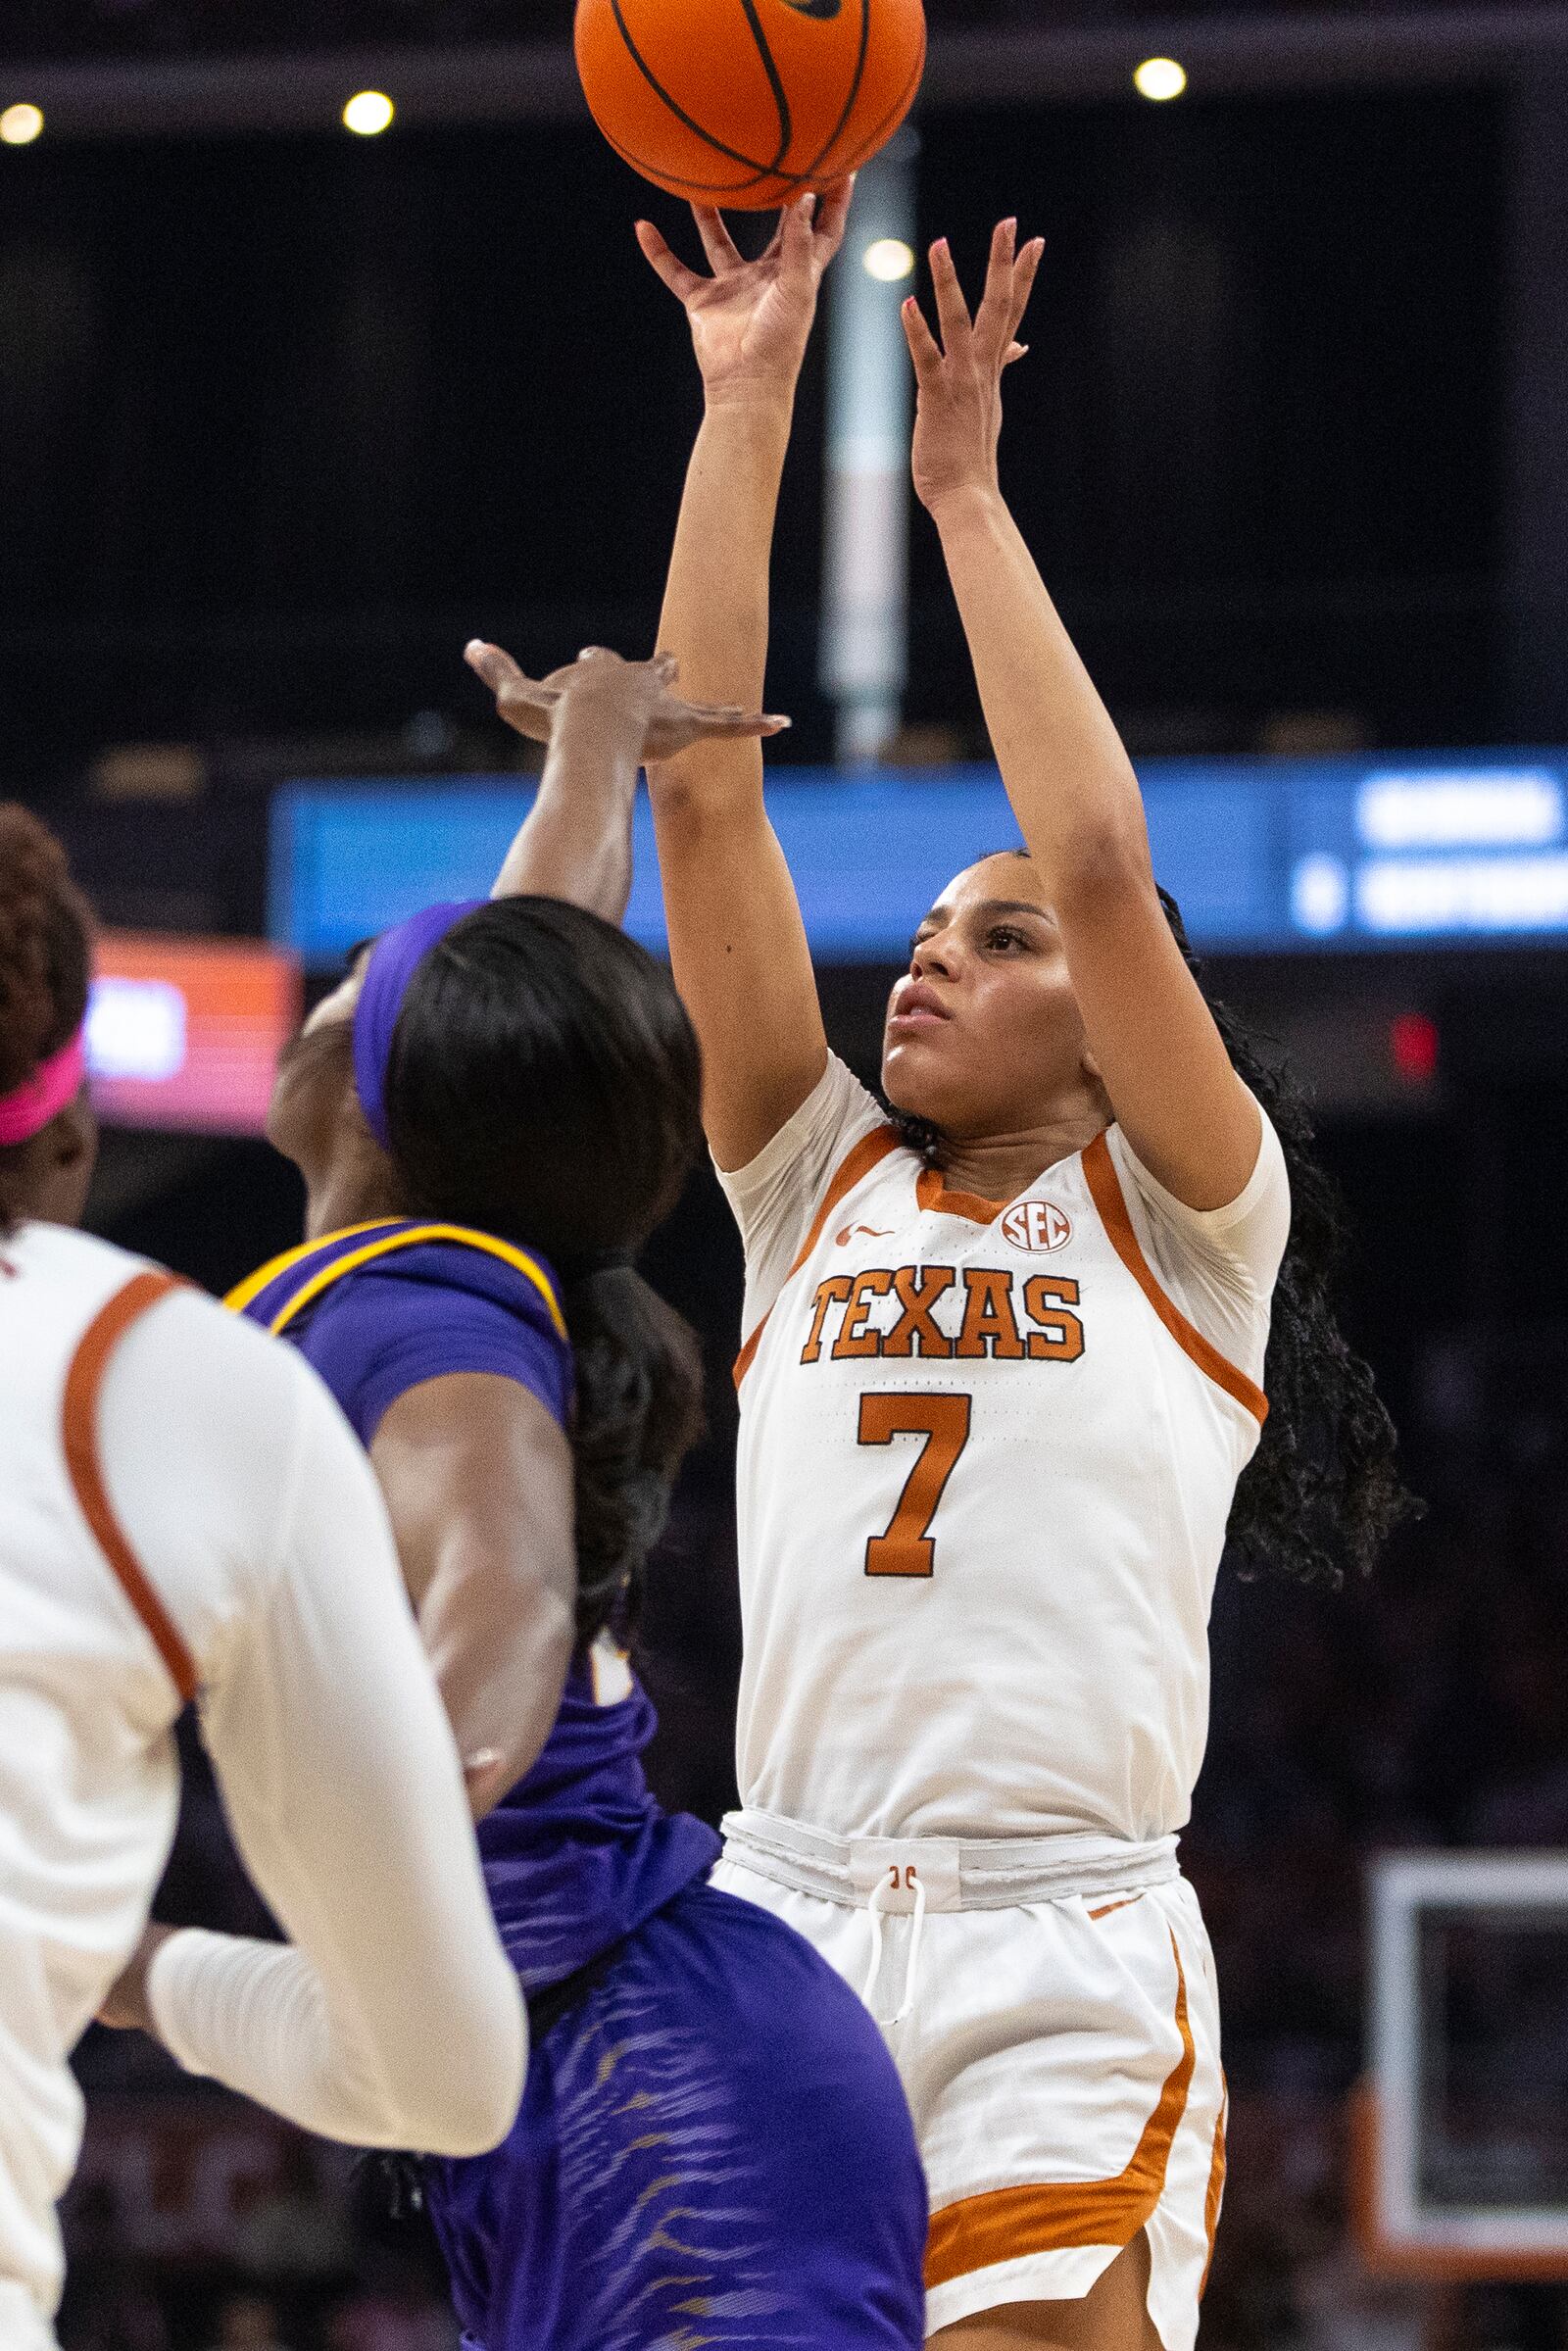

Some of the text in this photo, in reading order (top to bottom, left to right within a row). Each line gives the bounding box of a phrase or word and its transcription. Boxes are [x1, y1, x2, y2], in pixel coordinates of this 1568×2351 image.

[1004, 1202, 1068, 1250] SEC
[800, 1265, 1085, 1365] TEXAS
[858, 1393, 971, 1577] 7
